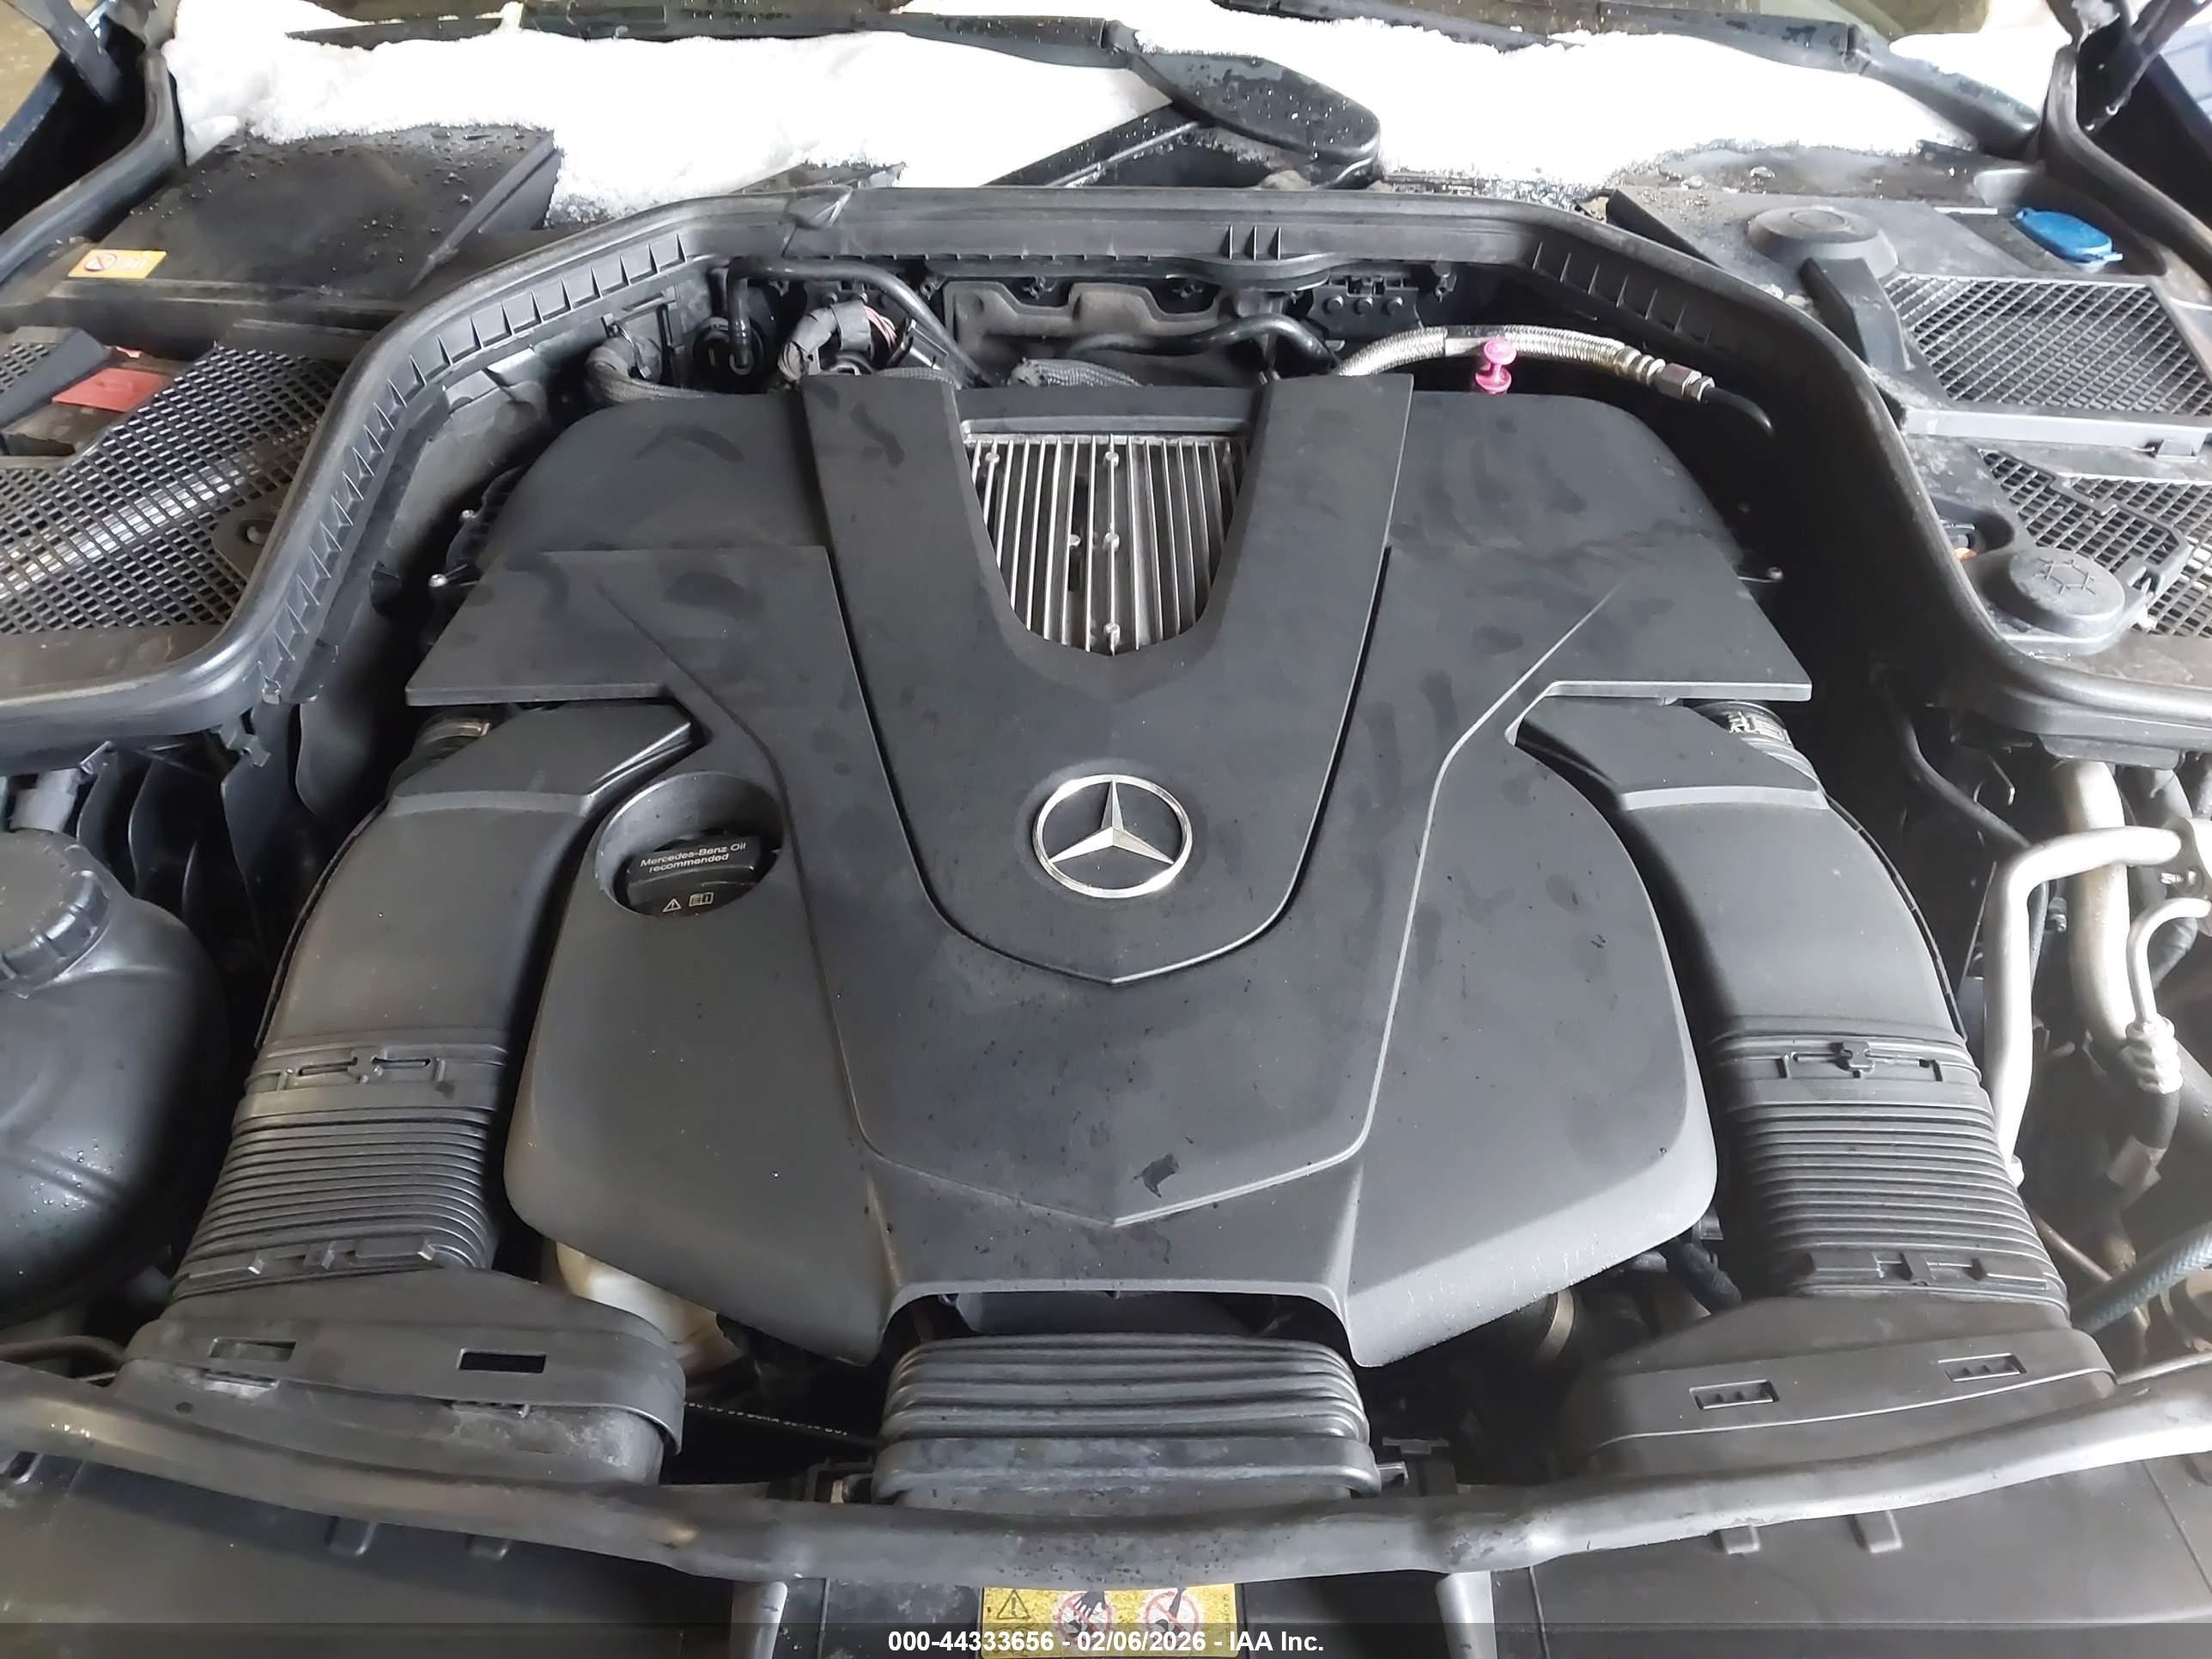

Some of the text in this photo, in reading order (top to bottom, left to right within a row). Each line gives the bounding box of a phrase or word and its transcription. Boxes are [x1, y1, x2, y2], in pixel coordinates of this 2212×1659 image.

[640, 842, 746, 867] Mercedes-Benz Oil
[649, 853, 729, 873] recommended
